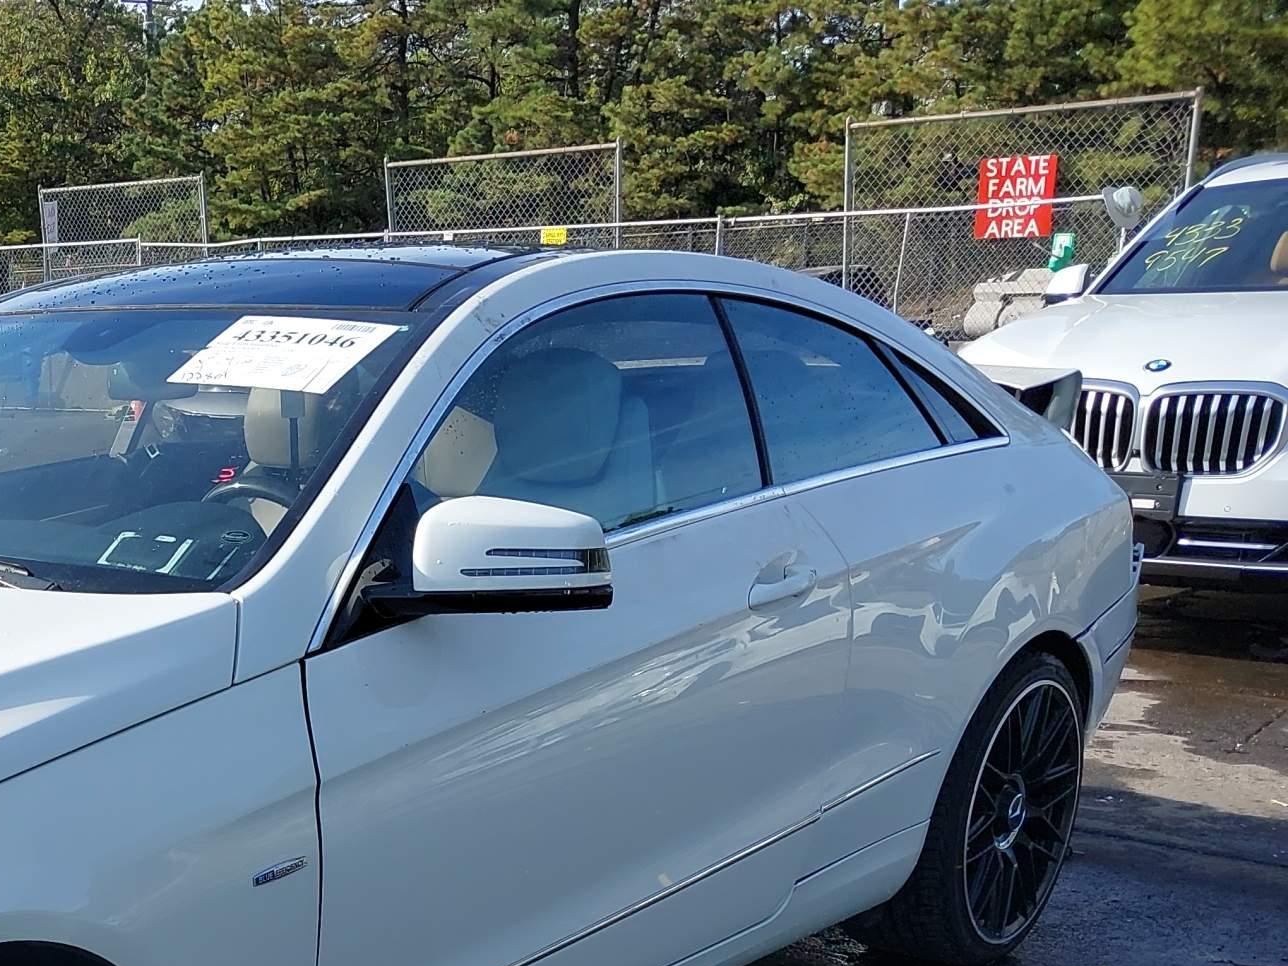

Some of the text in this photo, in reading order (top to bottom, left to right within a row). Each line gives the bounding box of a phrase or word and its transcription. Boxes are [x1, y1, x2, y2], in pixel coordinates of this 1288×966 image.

[986, 154, 1050, 177] STATE
[987, 176, 1046, 198] FARM
[987, 197, 1042, 218] DROP
[983, 218, 1040, 239] AREA
[1165, 218, 1243, 247] 4333
[1144, 246, 1230, 271] 9547
[231, 329, 361, 349] 43351046
